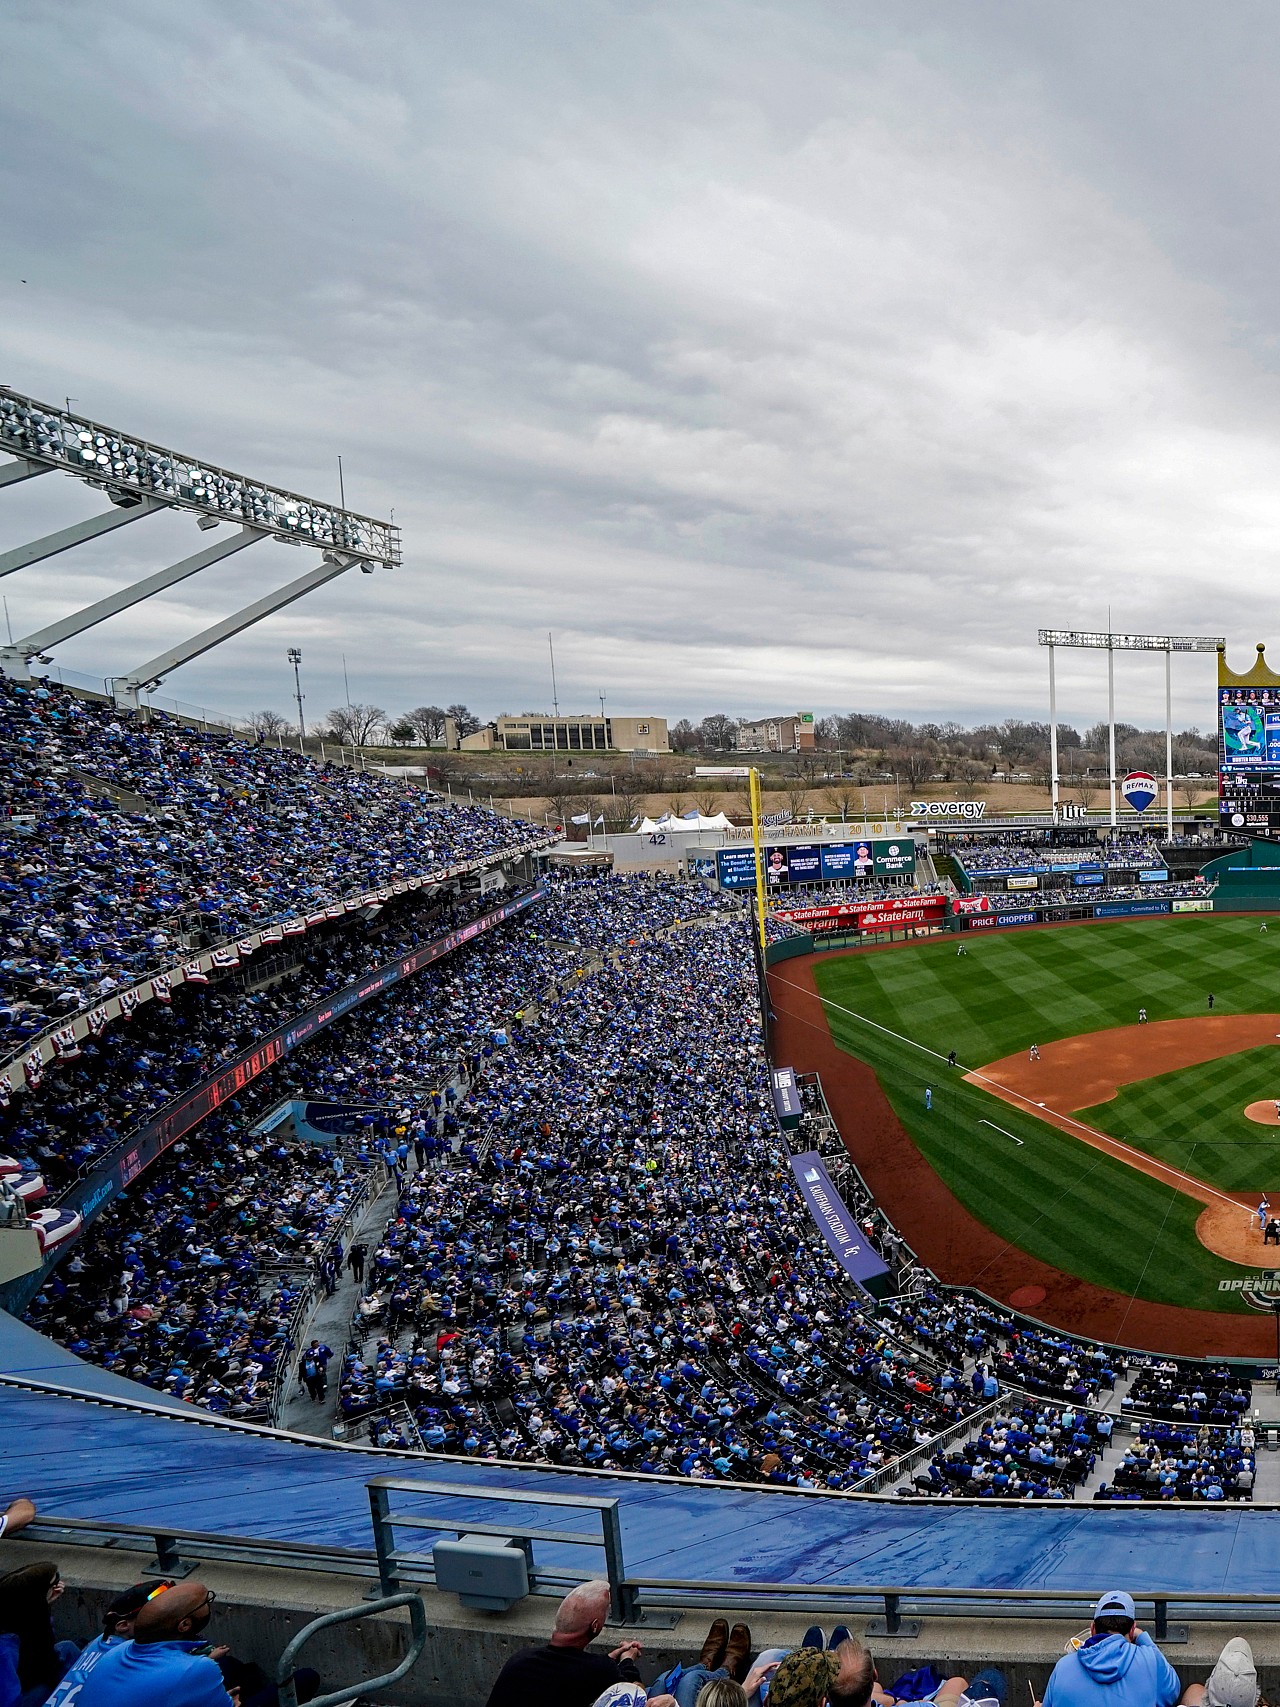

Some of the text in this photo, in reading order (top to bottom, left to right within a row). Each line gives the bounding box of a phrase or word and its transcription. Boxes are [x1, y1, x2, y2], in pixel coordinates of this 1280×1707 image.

[929, 802, 985, 818] evergy
[1062, 804, 1087, 820] Lite
[758, 810, 792, 826] Royals
[784, 825, 823, 837] FAME
[850, 825, 862, 834] 20
[872, 824, 882, 834] 10
[895, 823, 901, 832] 5
[650, 834, 666, 845] 42
[972, 914, 1034, 927] PRICE CHOPPER
[777, 1071, 792, 1088] UMB
[316, 1112, 344, 1121] RESTROOMS
[82, 1180, 114, 1217] BlueKC.com
[809, 1185, 860, 1258] KAUFFMAN STADIUM KC
